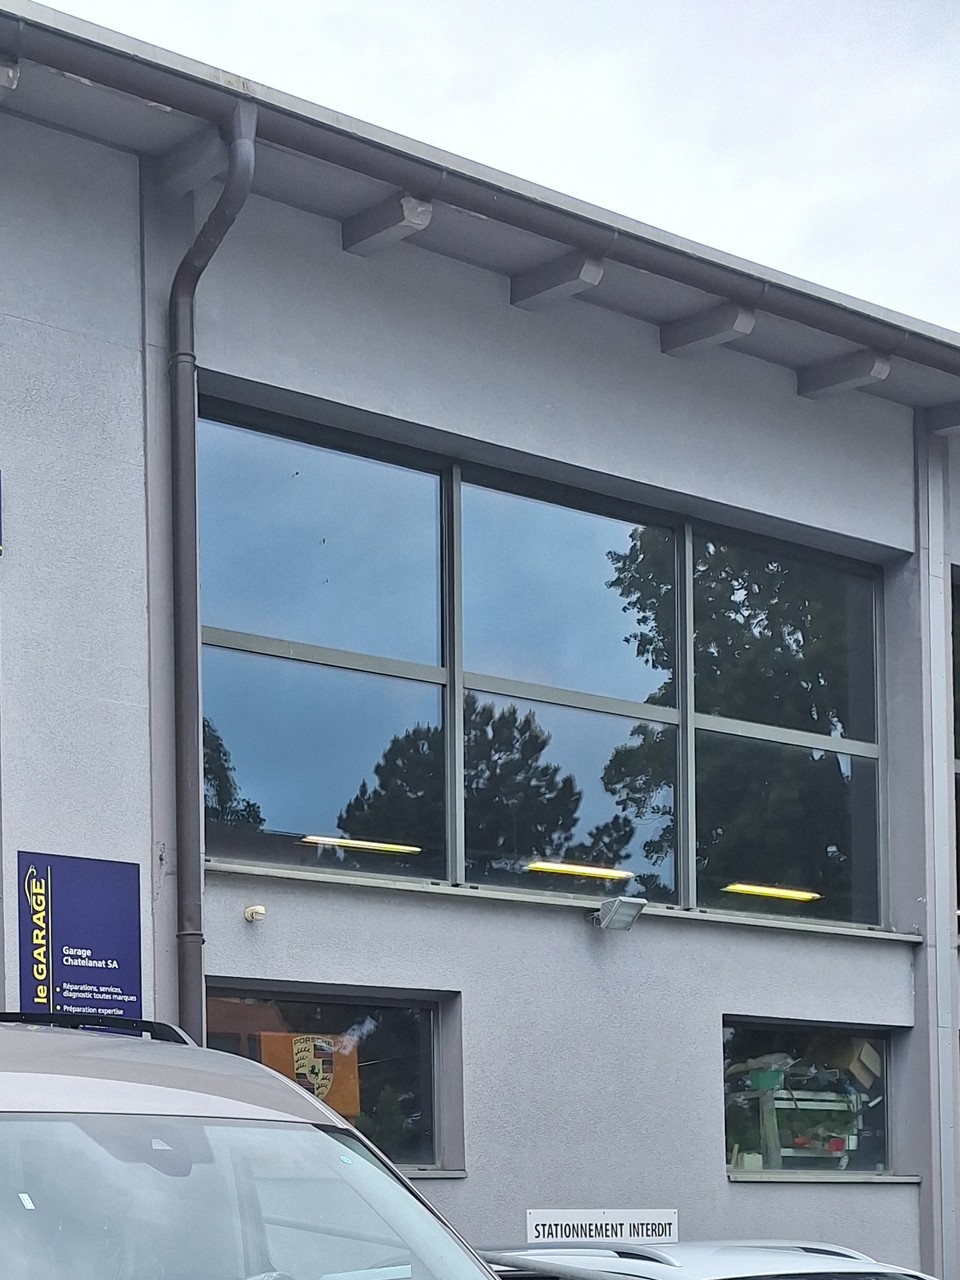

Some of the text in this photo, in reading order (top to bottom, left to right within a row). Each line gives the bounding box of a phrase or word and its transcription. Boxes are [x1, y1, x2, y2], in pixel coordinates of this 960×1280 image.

[32, 878, 47, 1003] le GARAGE
[62, 946, 92, 958] Garage
[62, 956, 119, 969] Chatelanat SA
[63, 983, 123, 994] Réparations, services,
[63, 990, 93, 999] diagnostic
[113, 995, 137, 1003] marques
[62, 1004, 124, 1016] Préparation expertise
[294, 1037, 333, 1047] PORSCHE
[534, 1222, 673, 1239] STATIONNEMENT INTERDIT
